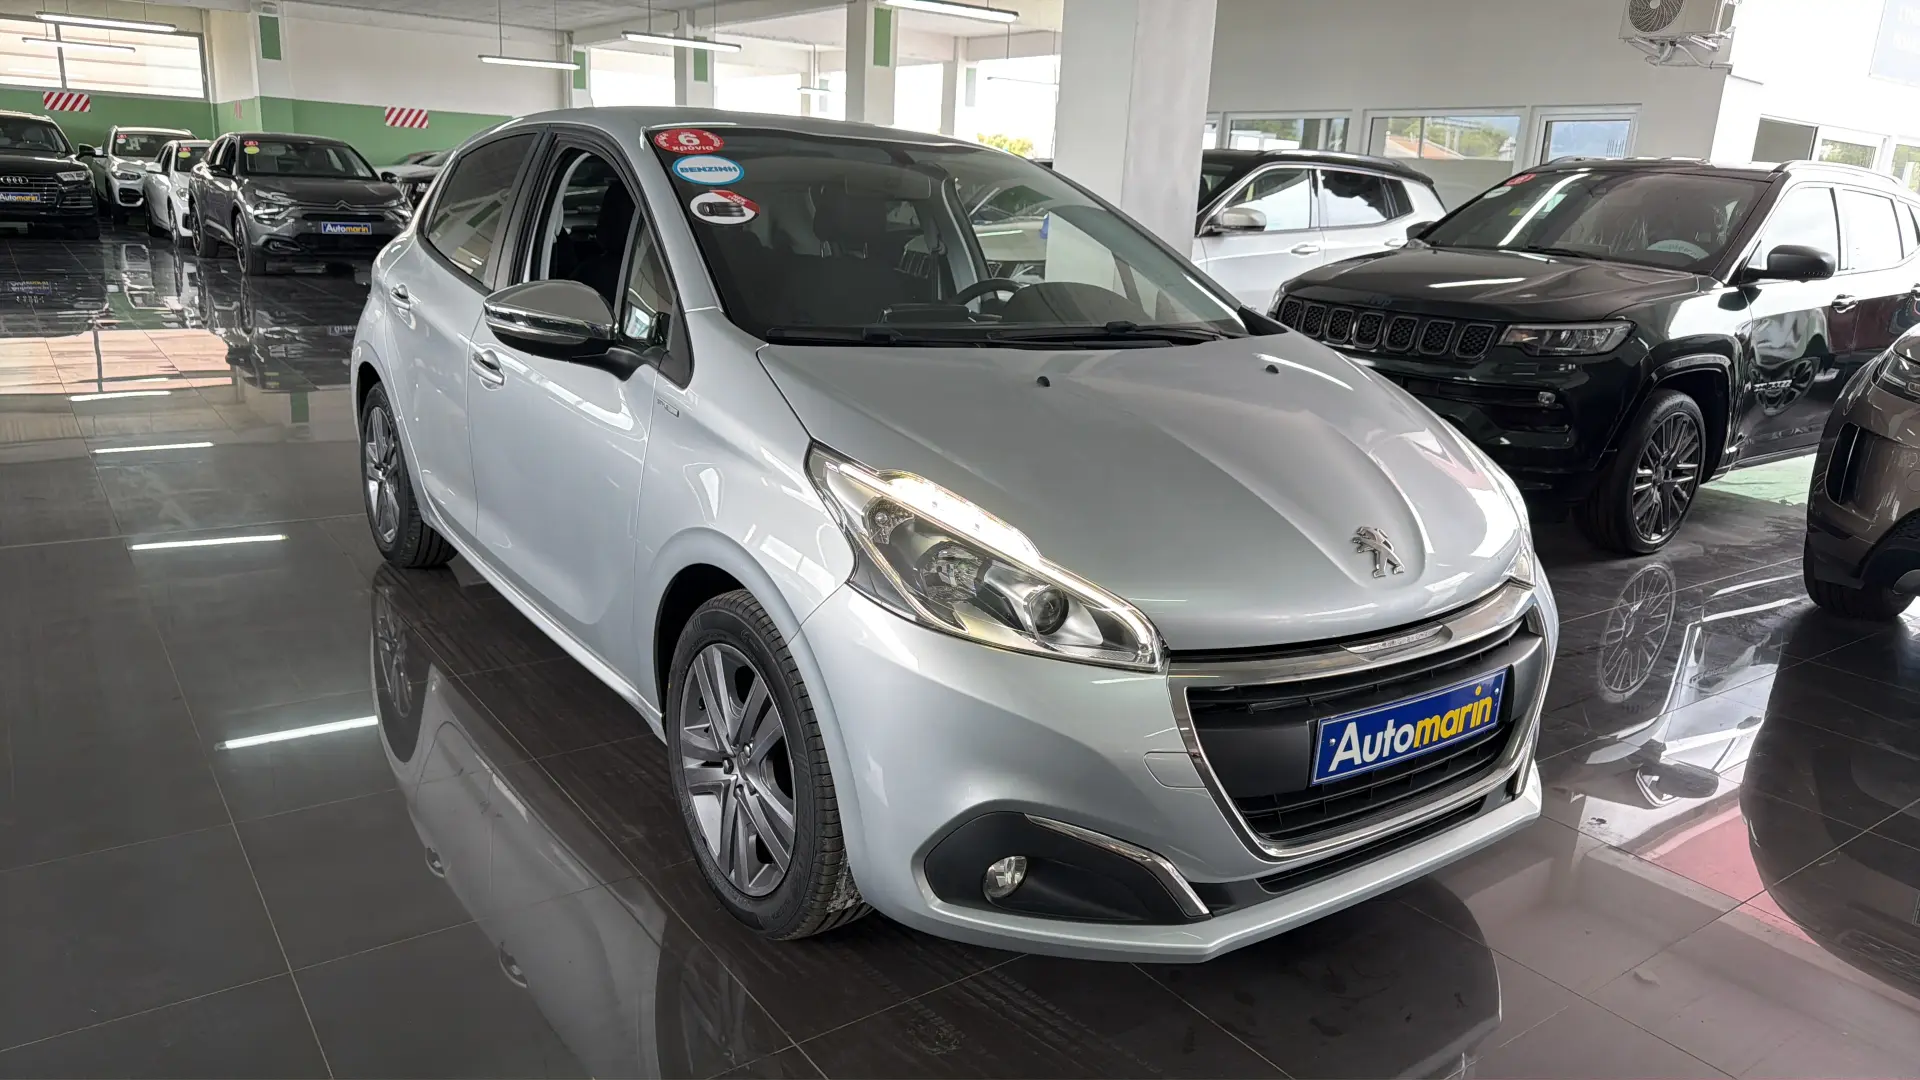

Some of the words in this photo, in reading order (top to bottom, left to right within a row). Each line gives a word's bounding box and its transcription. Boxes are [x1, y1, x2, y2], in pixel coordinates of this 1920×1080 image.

[678, 134, 700, 146] 6
[325, 223, 369, 233] Automarin
[1328, 685, 1493, 773] Automarin
